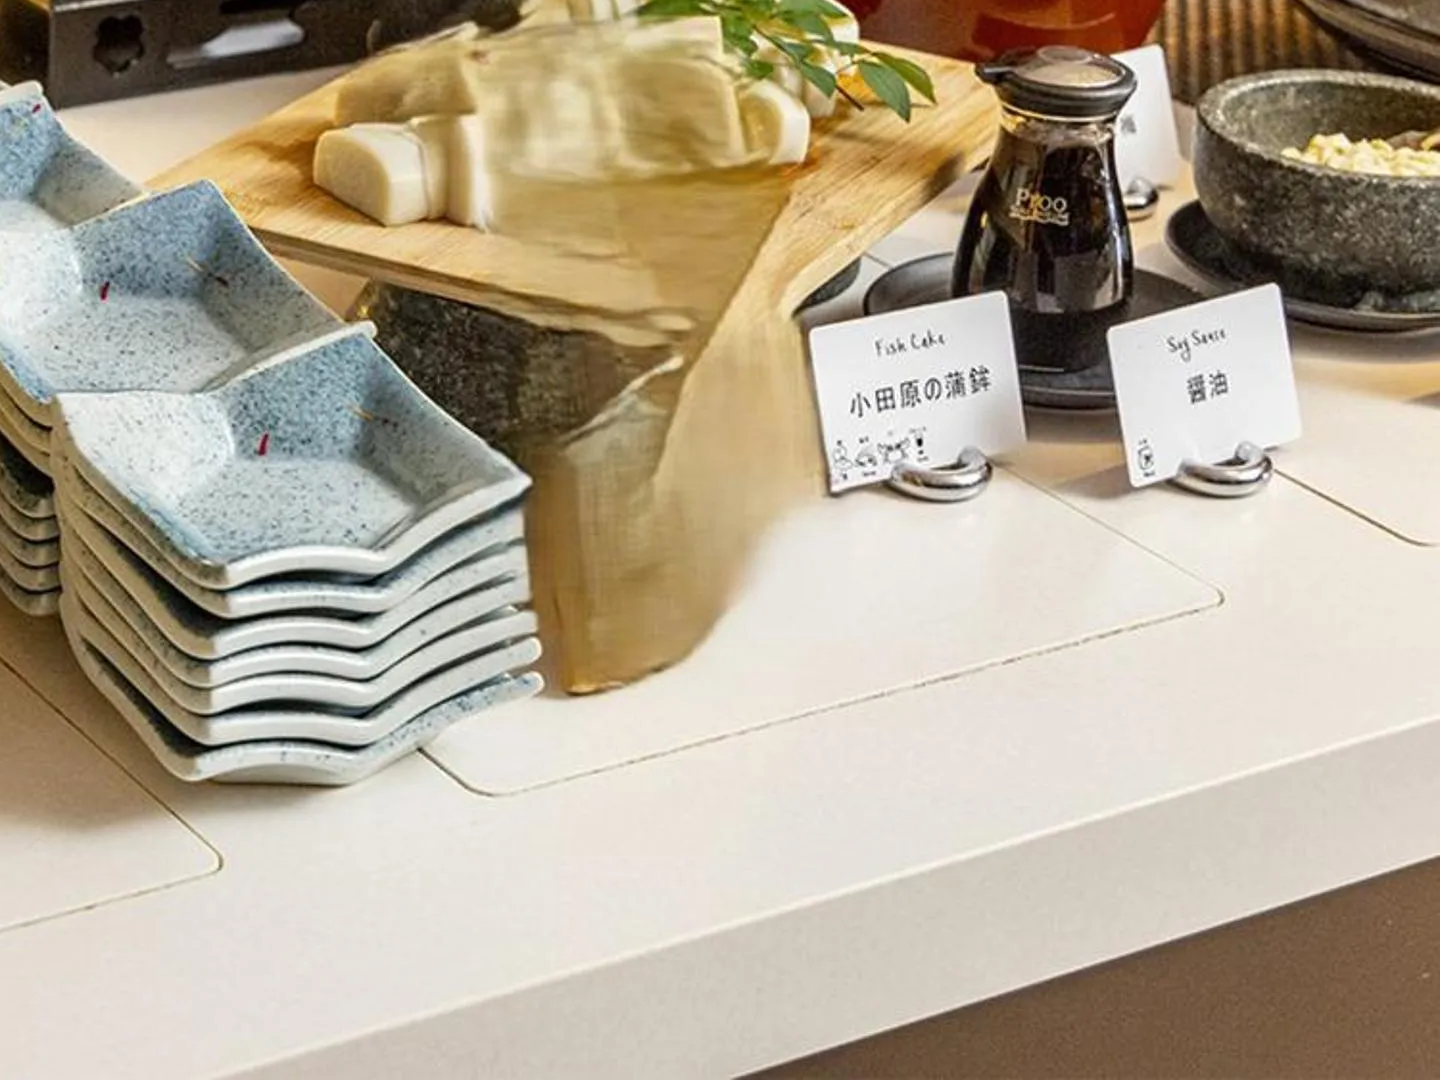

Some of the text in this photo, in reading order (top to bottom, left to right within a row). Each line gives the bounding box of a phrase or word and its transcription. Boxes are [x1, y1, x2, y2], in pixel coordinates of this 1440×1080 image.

[874, 328, 945, 357] Fish Cake
[849, 364, 992, 418] 小田原の蒲鉾
[1186, 370, 1228, 404] 醤油
